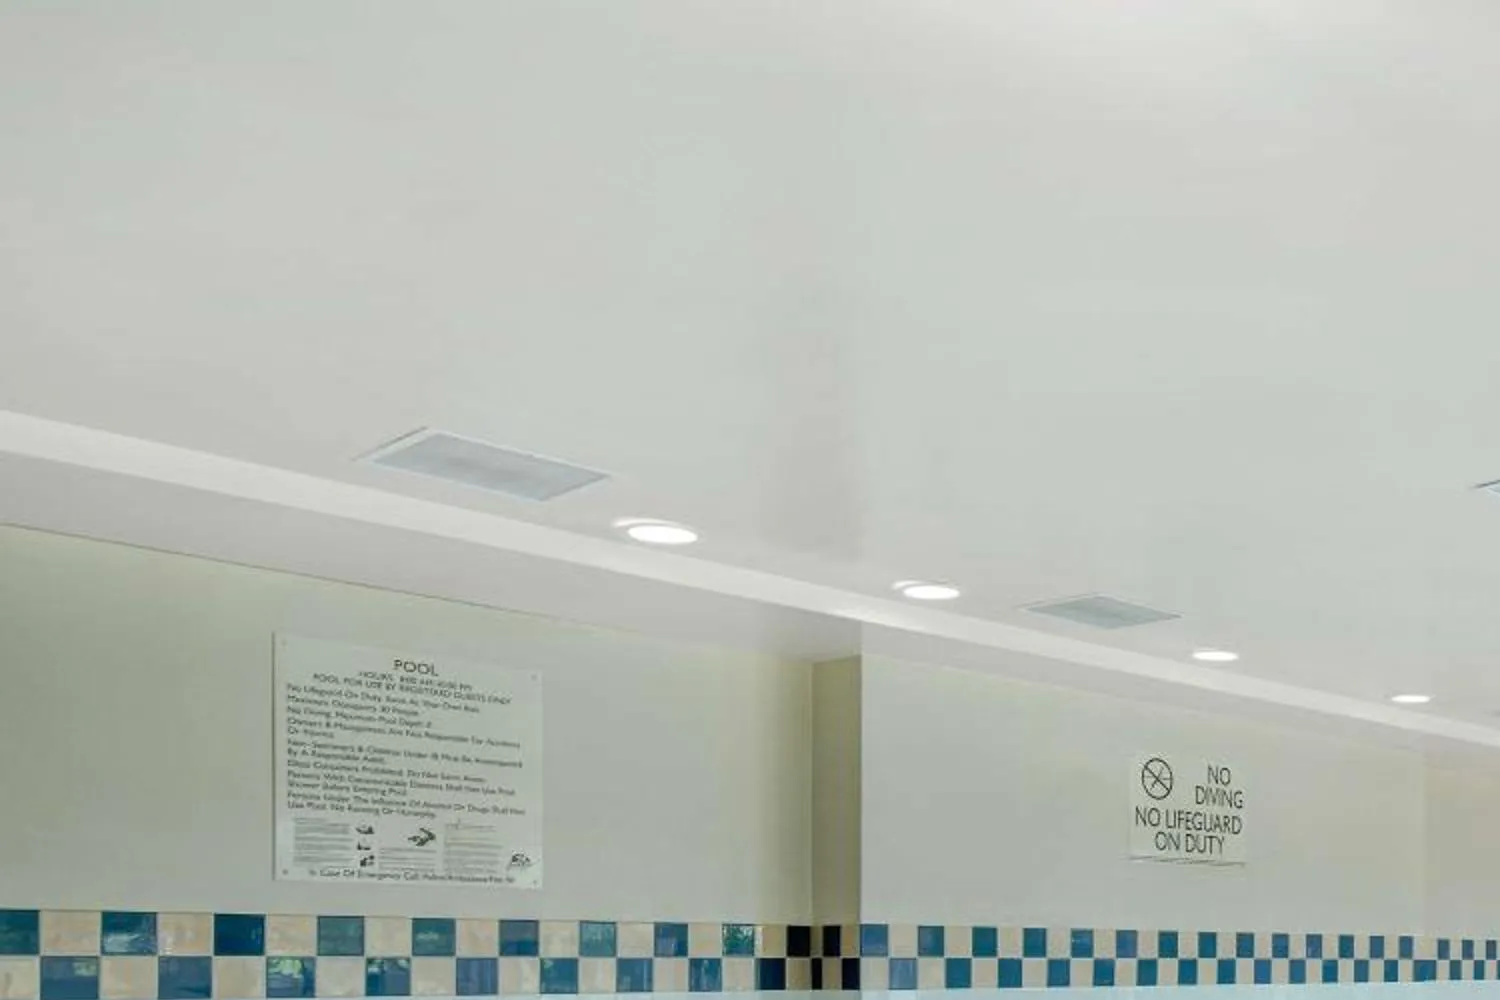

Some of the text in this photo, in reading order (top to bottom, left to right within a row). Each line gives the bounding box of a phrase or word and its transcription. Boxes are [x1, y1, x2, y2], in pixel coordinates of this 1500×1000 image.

[394, 659, 439, 677] POOL
[385, 682, 397, 691] BY
[1207, 765, 1231, 786] NO
[1195, 785, 1243, 809] DIVING
[1135, 805, 1243, 835] NO LIFEGUARD
[1155, 831, 1225, 855] ON DUTY
